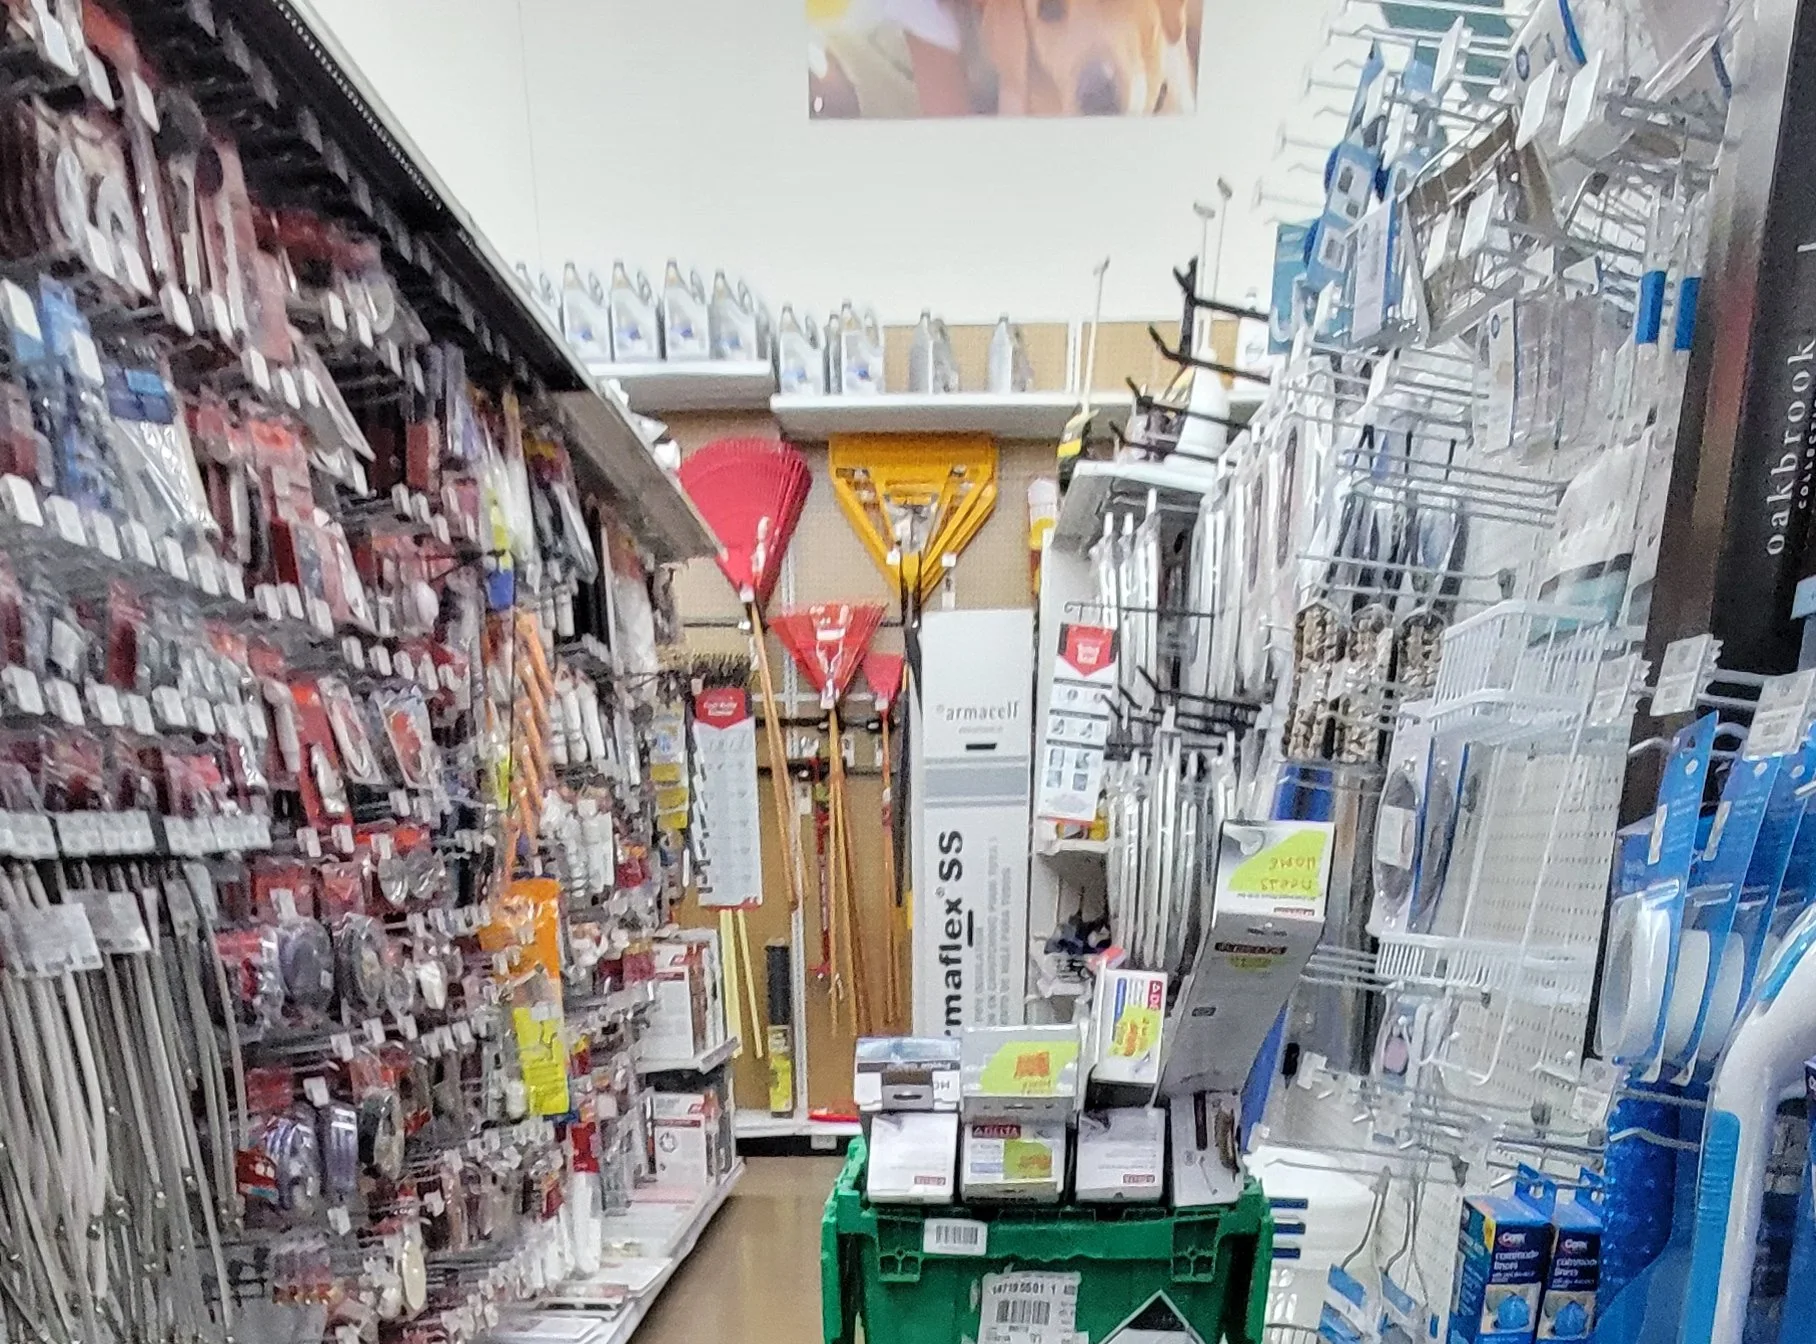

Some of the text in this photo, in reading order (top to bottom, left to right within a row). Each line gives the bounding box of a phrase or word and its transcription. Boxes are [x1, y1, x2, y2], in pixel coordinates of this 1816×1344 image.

[1766, 338, 1816, 556] oakbrook
[945, 701, 1019, 721] armacell
[938, 829, 965, 1037] maflex SS
